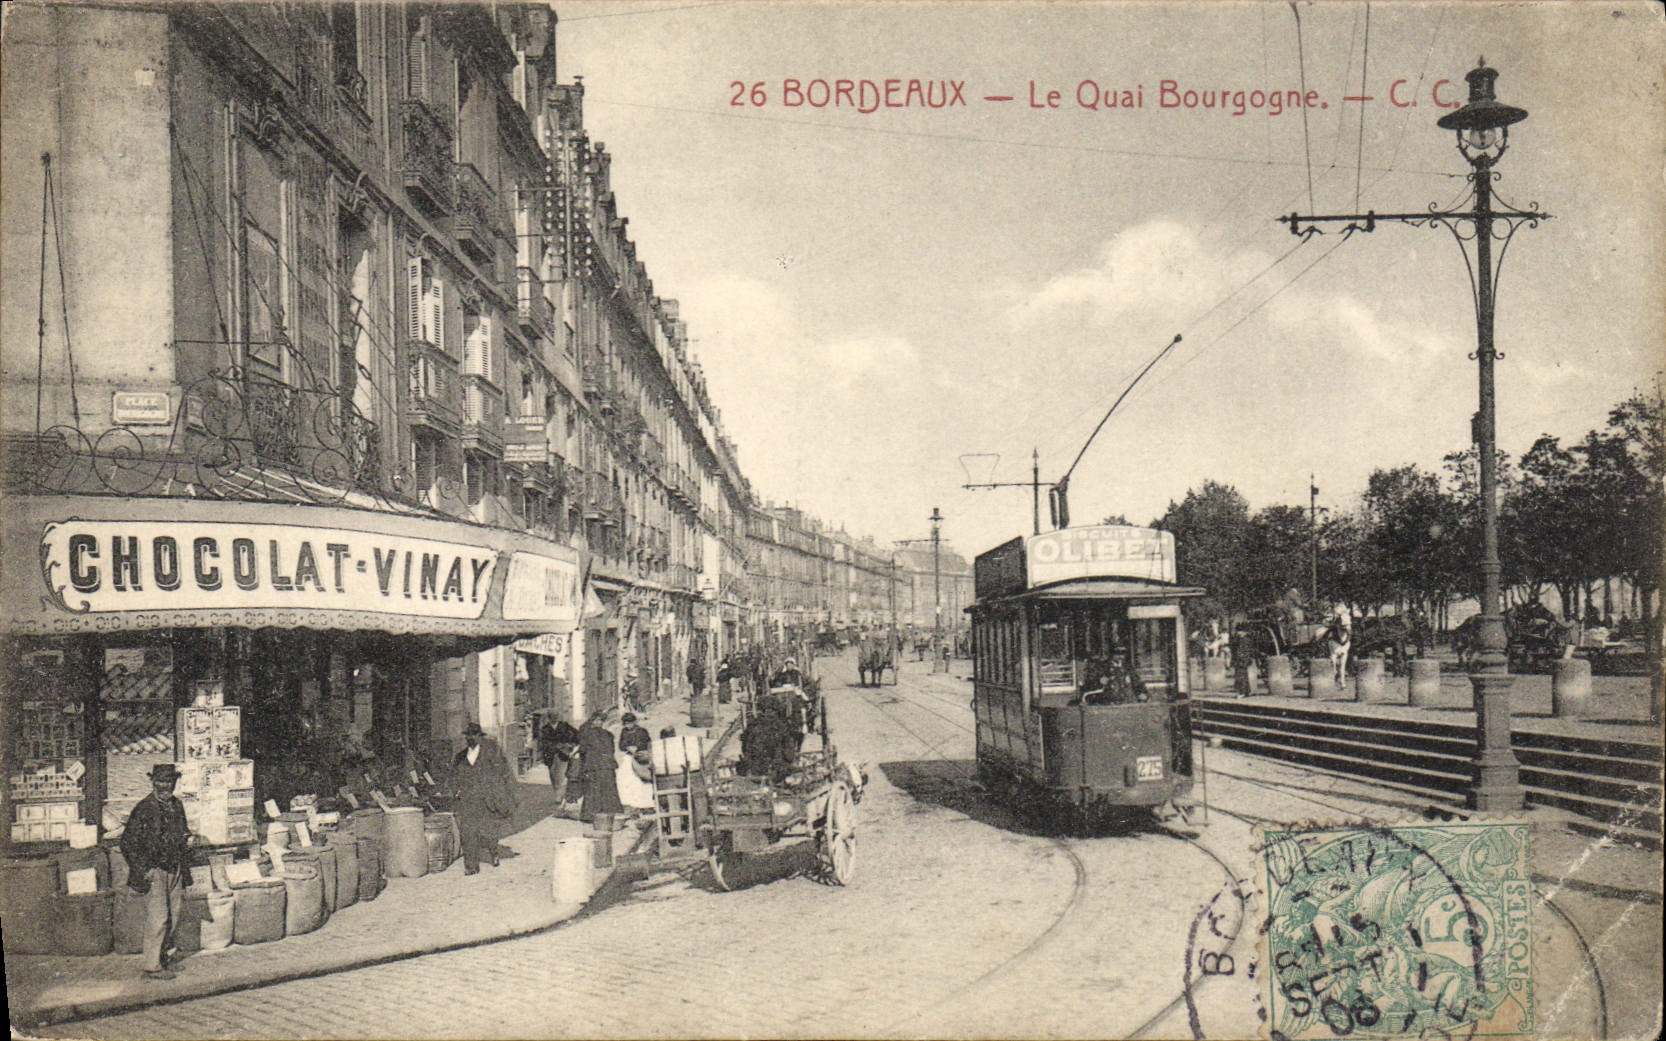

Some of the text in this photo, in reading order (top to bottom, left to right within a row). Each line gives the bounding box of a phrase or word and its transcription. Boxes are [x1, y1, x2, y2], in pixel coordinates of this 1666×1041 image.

[69, 533, 490, 602] CHOCOLAT-VINAY
[1034, 536, 1169, 564] OLIBET
[1506, 884, 1529, 975] POSTES
